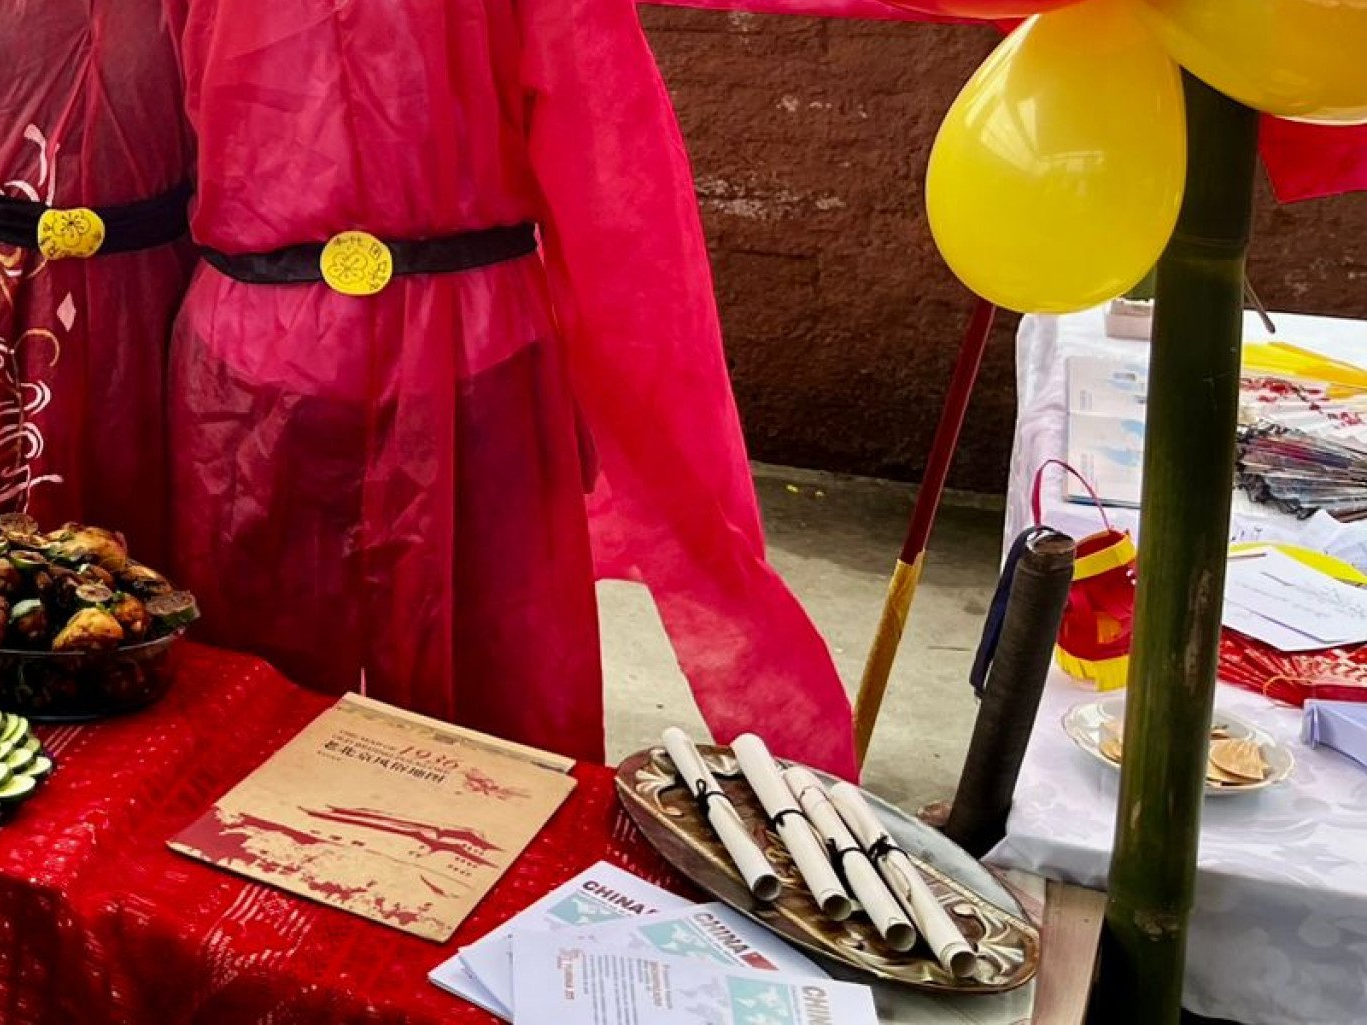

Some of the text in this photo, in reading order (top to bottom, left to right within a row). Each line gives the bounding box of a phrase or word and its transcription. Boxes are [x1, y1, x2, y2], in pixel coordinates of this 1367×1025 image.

[582, 880, 645, 914] CHINA
[693, 912, 750, 954] CHINA
[801, 985, 833, 1025] CHIN
